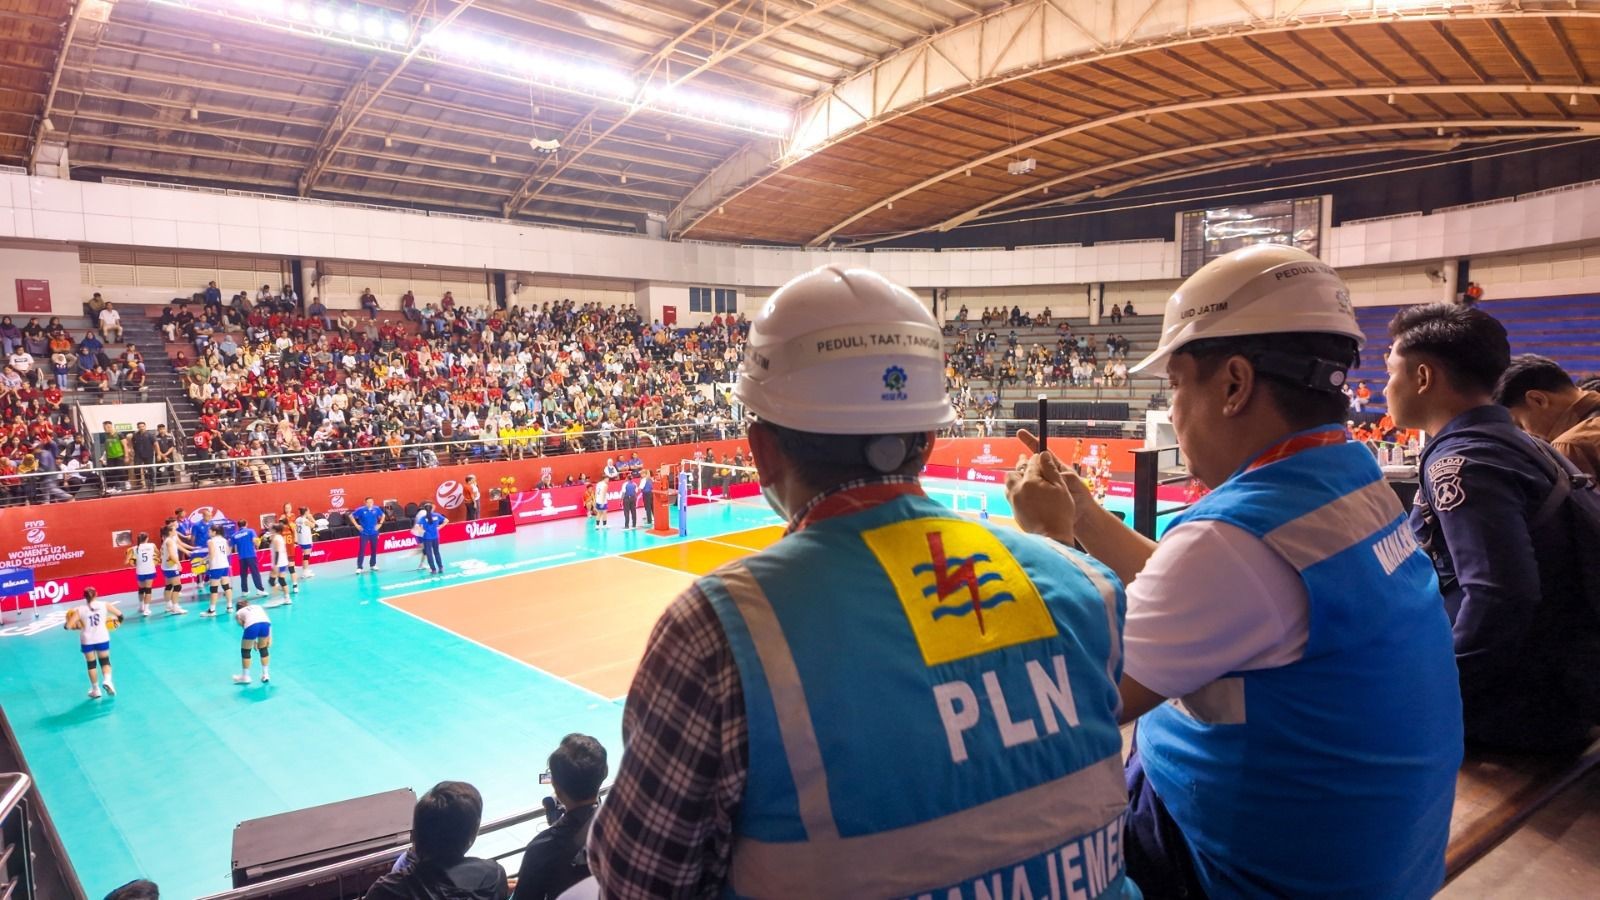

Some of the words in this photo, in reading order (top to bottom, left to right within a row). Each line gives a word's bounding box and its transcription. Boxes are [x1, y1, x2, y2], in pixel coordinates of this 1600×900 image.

[1180, 308, 1196, 319] UID
[1197, 302, 1228, 315] JATIM
[817, 337, 867, 353] PEDULI,
[24, 520, 45, 528] FIVB
[465, 521, 497, 539] Vidio
[0, 560, 22, 569] ORLD
[23, 550, 85, 566] CHAMPIONSHIP
[8, 547, 49, 560] WOMEN'S
[50, 545, 67, 554] U21
[141, 552, 149, 563] 5
[89, 613, 101, 627] 18
[932, 654, 1080, 764] PLN
